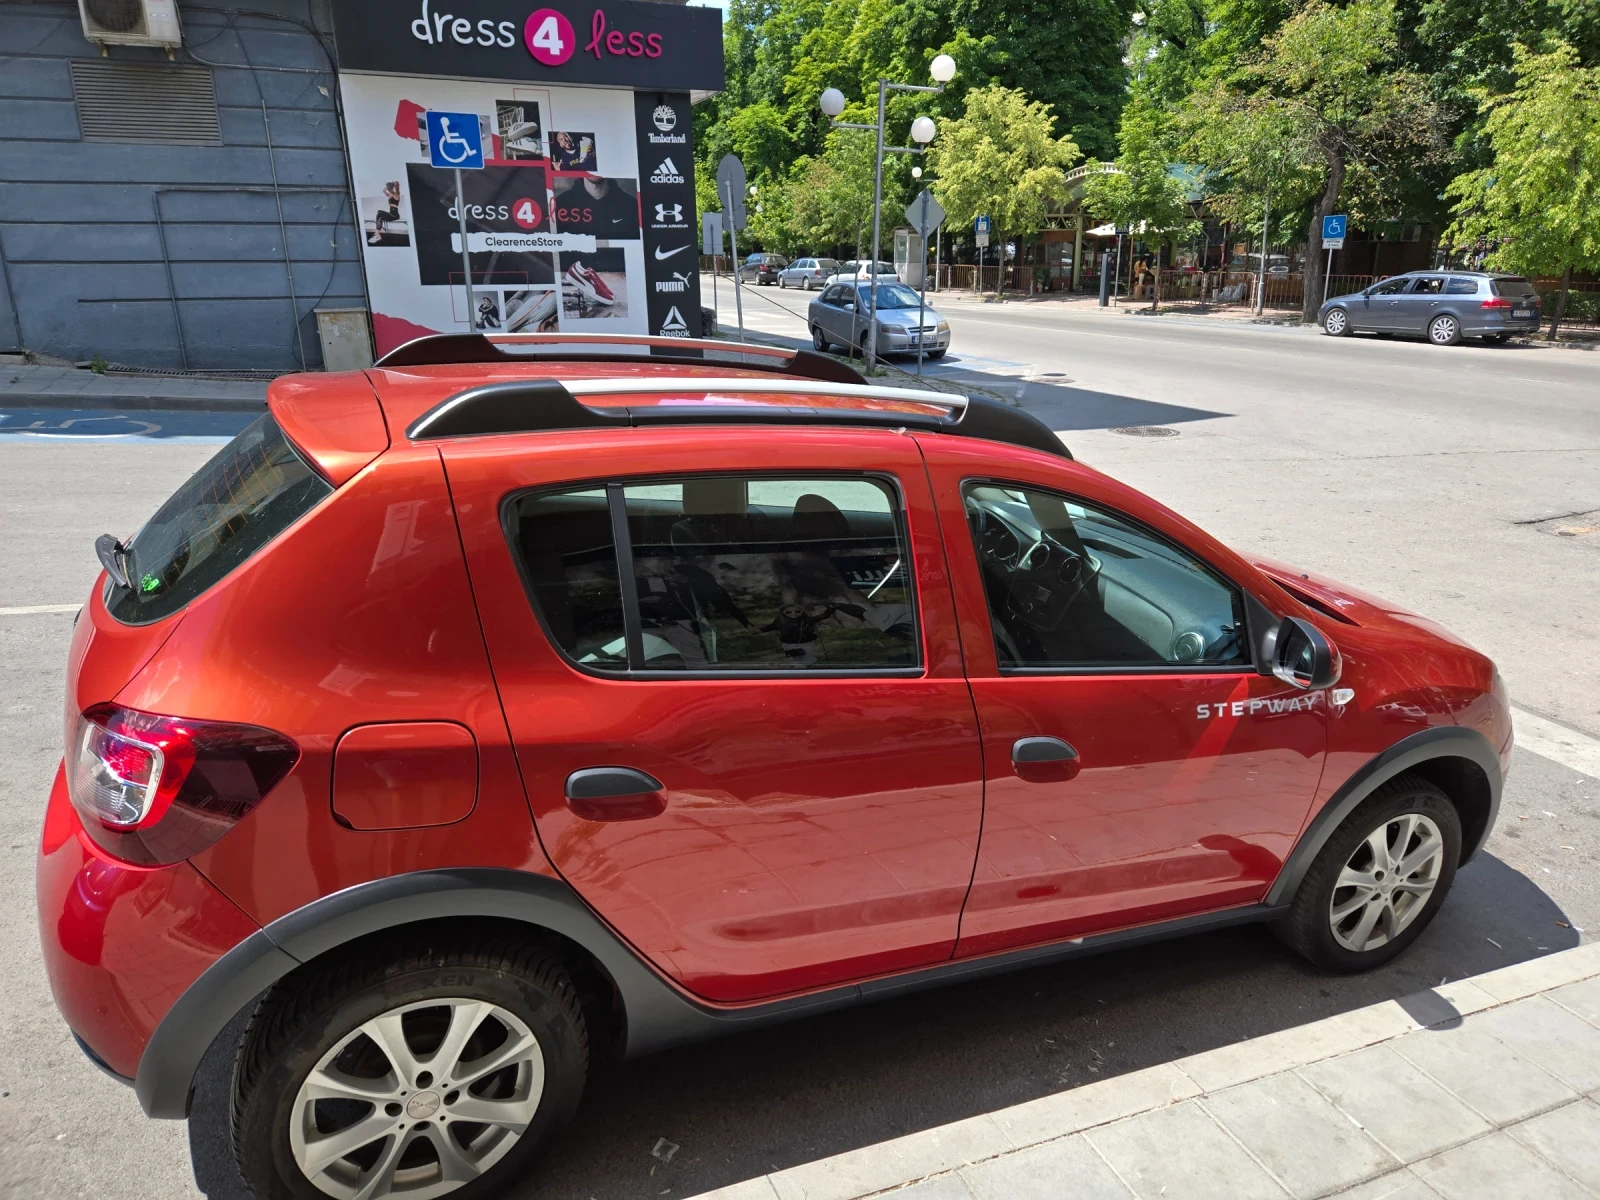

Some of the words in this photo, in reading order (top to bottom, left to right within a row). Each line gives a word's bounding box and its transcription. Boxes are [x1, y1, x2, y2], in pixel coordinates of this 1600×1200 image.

[411, 0, 516, 47] dress
[532, 16, 564, 56] 4
[584, 9, 663, 59] less
[648, 133, 686, 143] Timberland
[650, 174, 684, 183] adidas
[448, 196, 509, 221] dress
[516, 202, 535, 223] 4
[545, 197, 593, 224] less
[485, 237, 563, 247] ClearenceStore
[655, 281, 684, 292] PUMA
[1197, 697, 1316, 718] STEPWAY
